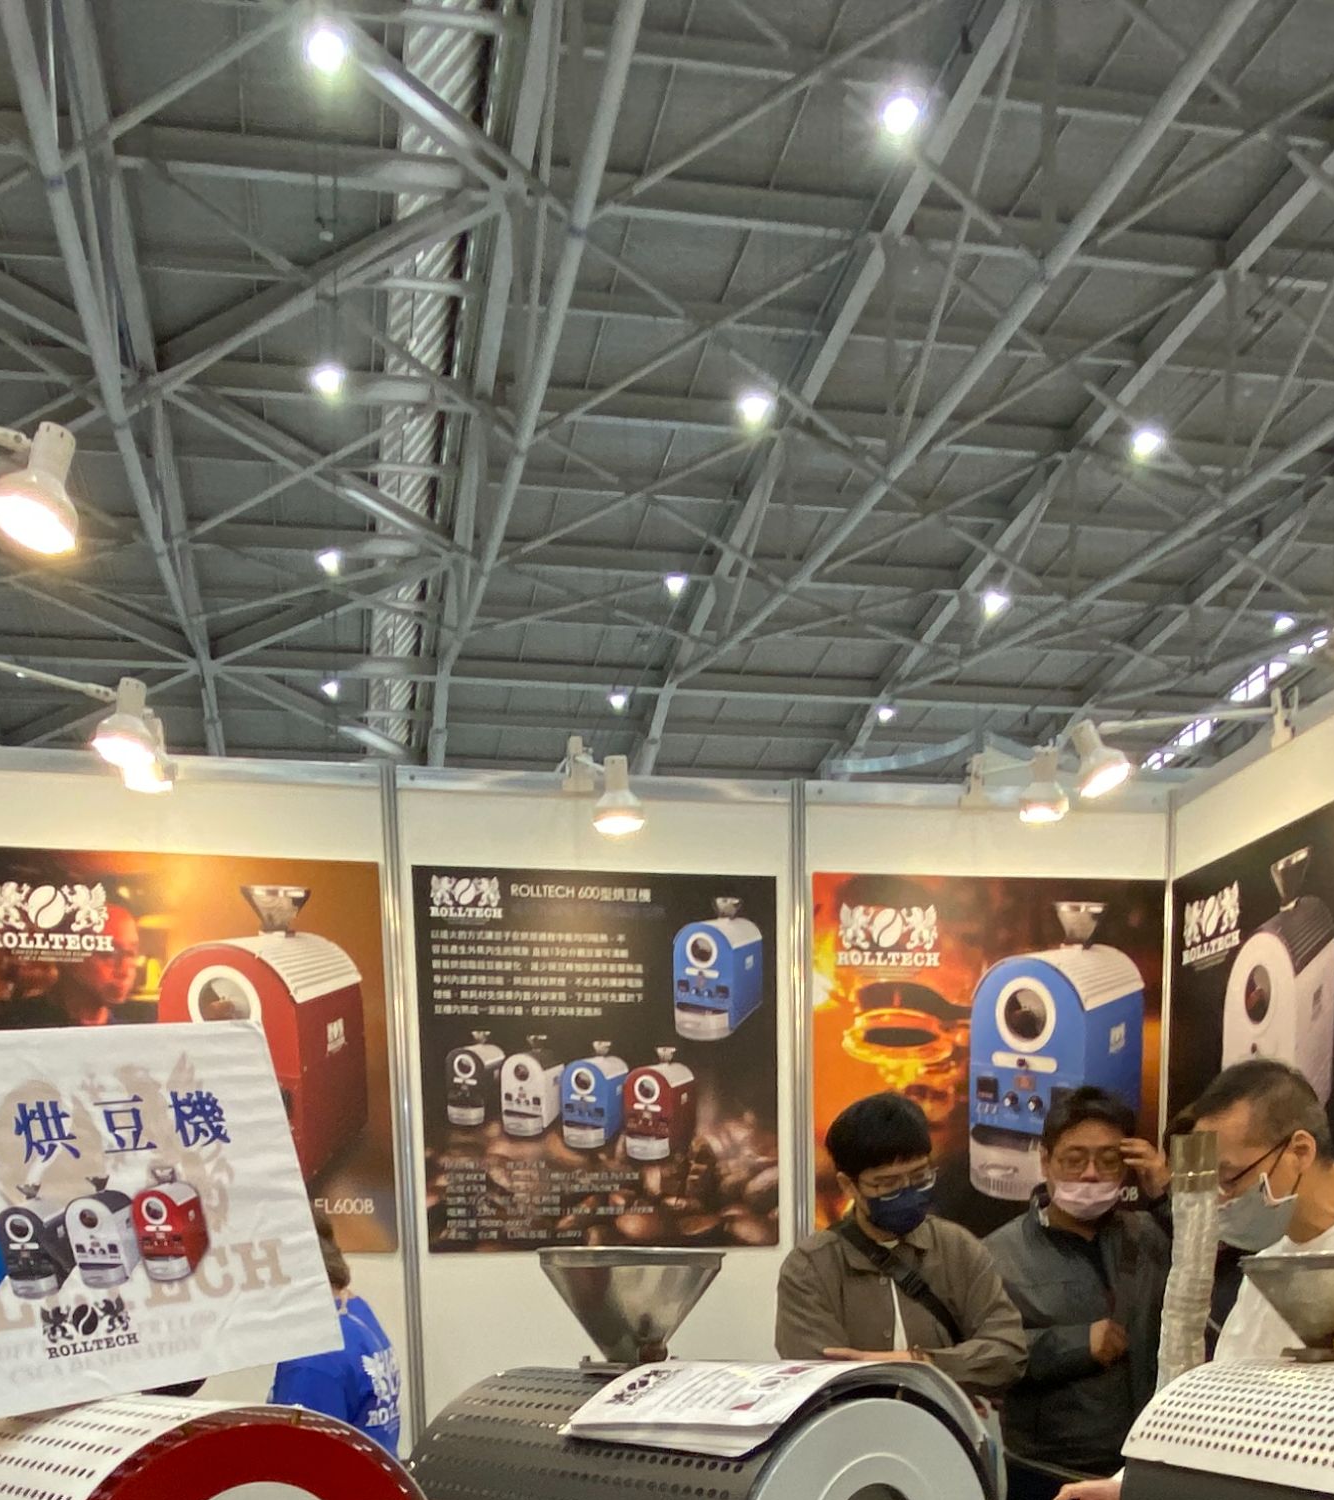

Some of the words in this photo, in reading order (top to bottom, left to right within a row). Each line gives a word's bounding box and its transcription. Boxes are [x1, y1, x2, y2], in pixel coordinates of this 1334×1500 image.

[510, 883, 575, 899] ROLLTECH
[429, 906, 503, 918] ROLLTECH
[837, 950, 941, 967] ROLLTECH
[46, 1333, 140, 1360] ROLLTECH
